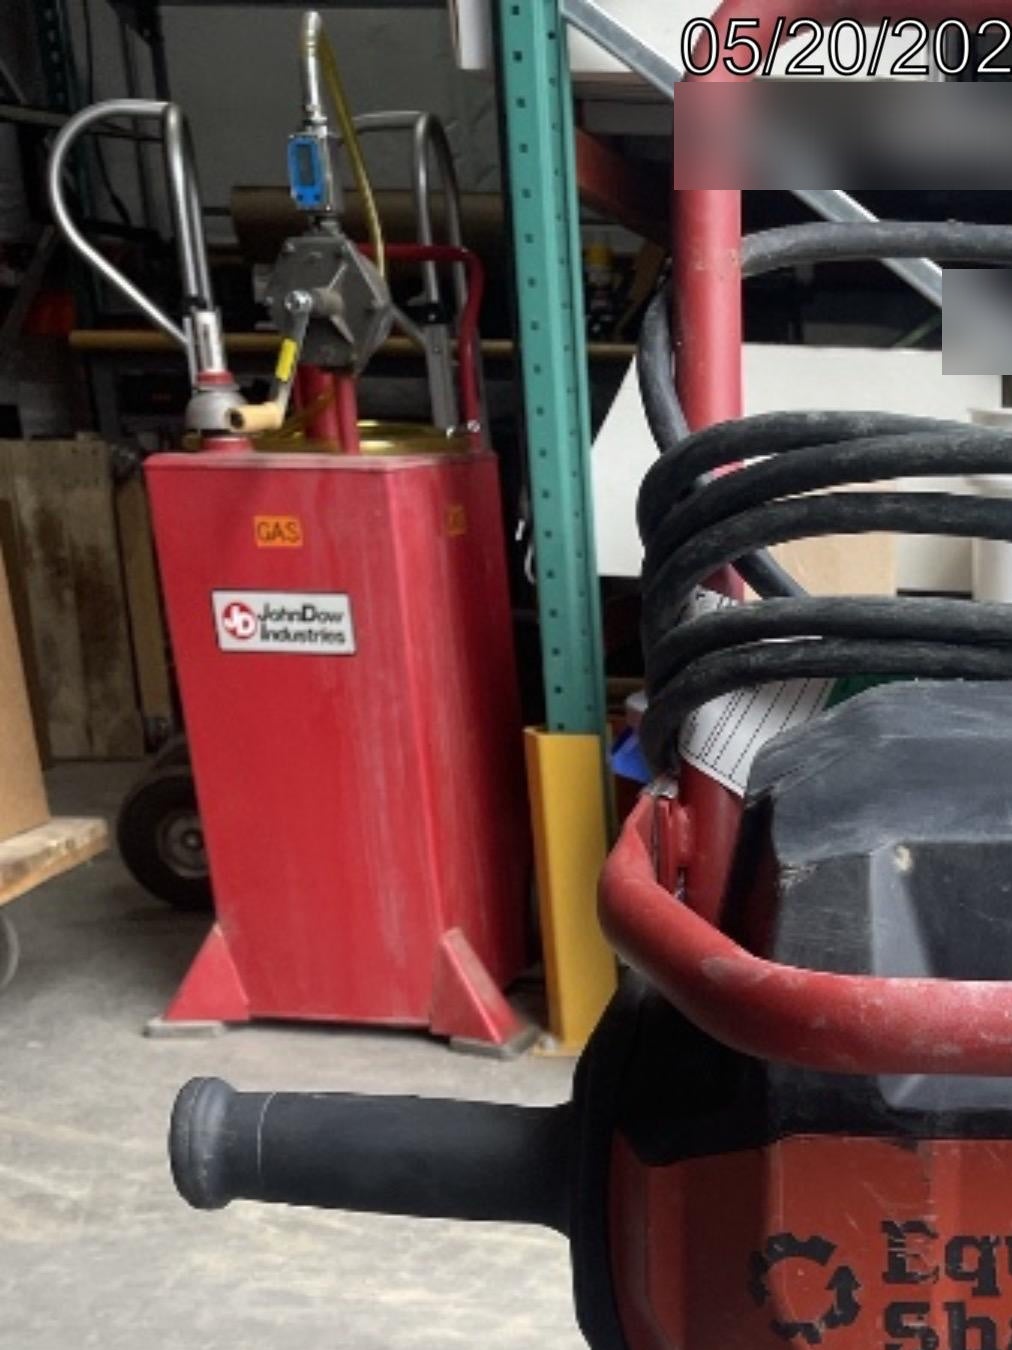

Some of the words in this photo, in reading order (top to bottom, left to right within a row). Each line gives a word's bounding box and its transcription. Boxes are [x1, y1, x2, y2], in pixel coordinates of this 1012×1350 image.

[256, 521, 299, 543] GAS
[258, 602, 343, 623] JohnDow
[260, 624, 346, 645] Industries
